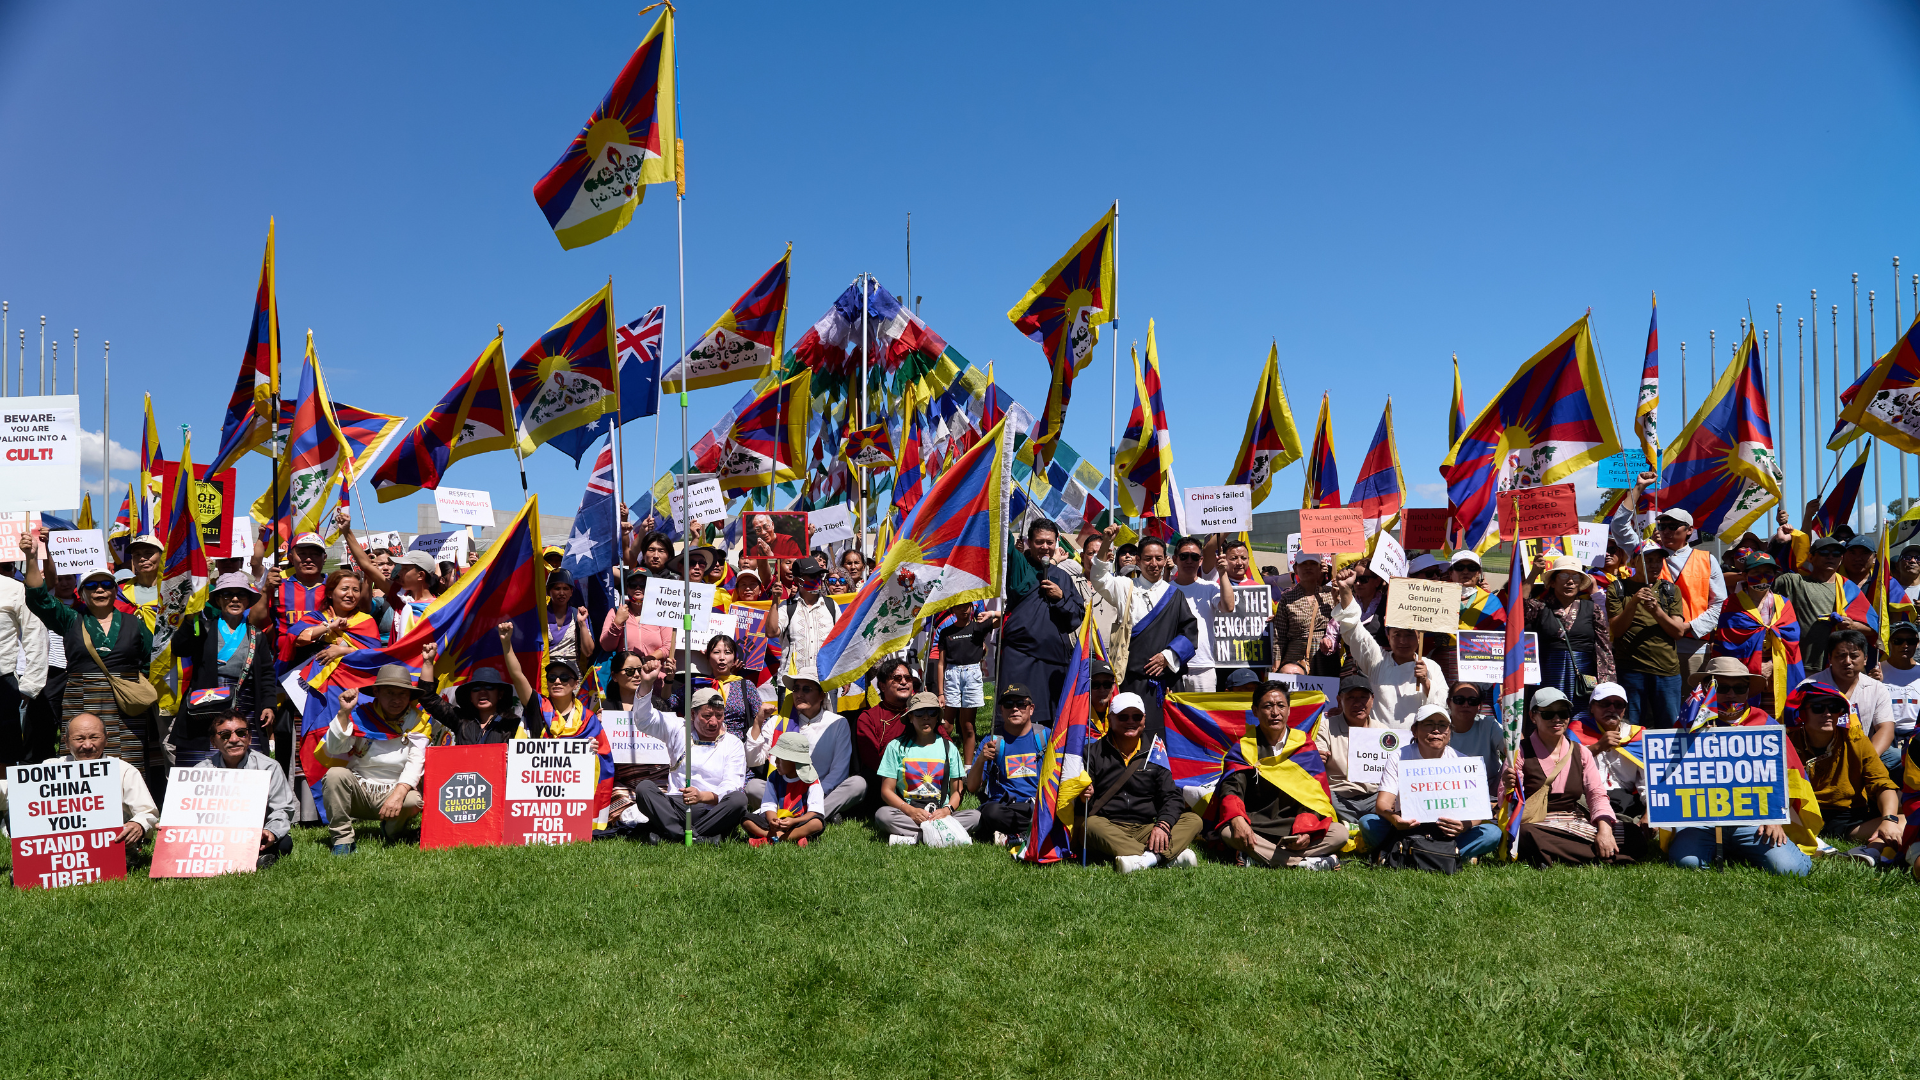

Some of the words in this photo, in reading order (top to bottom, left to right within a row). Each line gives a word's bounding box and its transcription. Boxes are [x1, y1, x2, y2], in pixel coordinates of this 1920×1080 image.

[4, 414, 56, 423] BEWARE:
[37, 434, 59, 442] INTO
[6, 448, 53, 461] CULT!
[198, 493, 216, 503] OP
[448, 490, 475, 498] RESPECT
[692, 488, 703, 496] Let
[1191, 493, 1221, 501] China's
[1222, 491, 1244, 499] failed
[439, 498, 464, 506] HUMAN
[466, 500, 489, 508] RIGHTS
[695, 498, 713, 507] Lama
[704, 508, 721, 516] Tibet
[1203, 505, 1233, 513] policies
[1201, 518, 1220, 526] Must
[1222, 517, 1237, 525] end
[1333, 513, 1362, 522] genuine
[202, 527, 218, 535] BET!
[823, 520, 844, 531] Tibet!
[1312, 526, 1353, 535] autonomy
[1413, 524, 1432, 532] Tibet
[1543, 522, 1568, 530] TIBET
[56, 536, 83, 544] China:
[1316, 539, 1328, 547] for
[1330, 538, 1353, 547] Tibet.
[659, 586, 680, 596] Tibet
[1408, 583, 1420, 591] We
[1422, 584, 1443, 593] Want
[655, 597, 681, 608] Never
[1243, 590, 1267, 613] THE
[1408, 594, 1441, 603] Genuine
[657, 610, 666, 618] of
[1398, 602, 1439, 614] Autonomy
[1441, 606, 1449, 614] in
[1413, 615, 1433, 623] Tibet
[1213, 616, 1269, 637] GENOCIDE
[1216, 640, 1231, 661] IN
[1233, 639, 1264, 661] TIBET
[516, 741, 560, 754] DON'T
[563, 741, 588, 754] LET
[612, 742, 665, 750] PRISONERS
[1648, 734, 1780, 760] RELIGIOUS
[1357, 751, 1378, 760] Long
[531, 756, 572, 768] CHINA
[1363, 764, 1385, 772] Dalai
[17, 764, 73, 783] DON'T
[79, 761, 110, 779] LET
[178, 770, 228, 783] DON'T
[1405, 765, 1461, 777] FREEDOM
[1464, 764, 1479, 774] OF
[1649, 760, 1777, 786] FREEDOM
[521, 770, 581, 784] SILENCE
[39, 781, 92, 798] CHINA
[194, 784, 240, 797] CHINA
[445, 785, 486, 798] STOP
[535, 785, 565, 798] YOU:
[1410, 781, 1460, 793] SPEECH
[1464, 780, 1477, 790] IN
[28, 795, 104, 817] SILENCE
[180, 798, 250, 812] SILENCE
[445, 797, 486, 806] CULTURAL
[445, 803, 486, 812] GENOCIDE
[1423, 797, 1469, 810] TIBET
[1651, 790, 1670, 807] in
[1675, 786, 1773, 818] TiBET
[511, 802, 562, 817] STAND
[566, 802, 587, 816] UP
[48, 815, 87, 831] YOU:
[196, 813, 230, 825] YOU:
[533, 818, 563, 832] FOR
[164, 829, 224, 843] STAND
[230, 830, 255, 844] UP
[523, 833, 572, 846] TIBET!
[20, 835, 85, 857] STAND
[90, 831, 116, 849] UP
[189, 844, 225, 858] FOR
[51, 851, 89, 871] FOR
[175, 859, 233, 874] TIBET!
[39, 867, 101, 890] TIBET!
